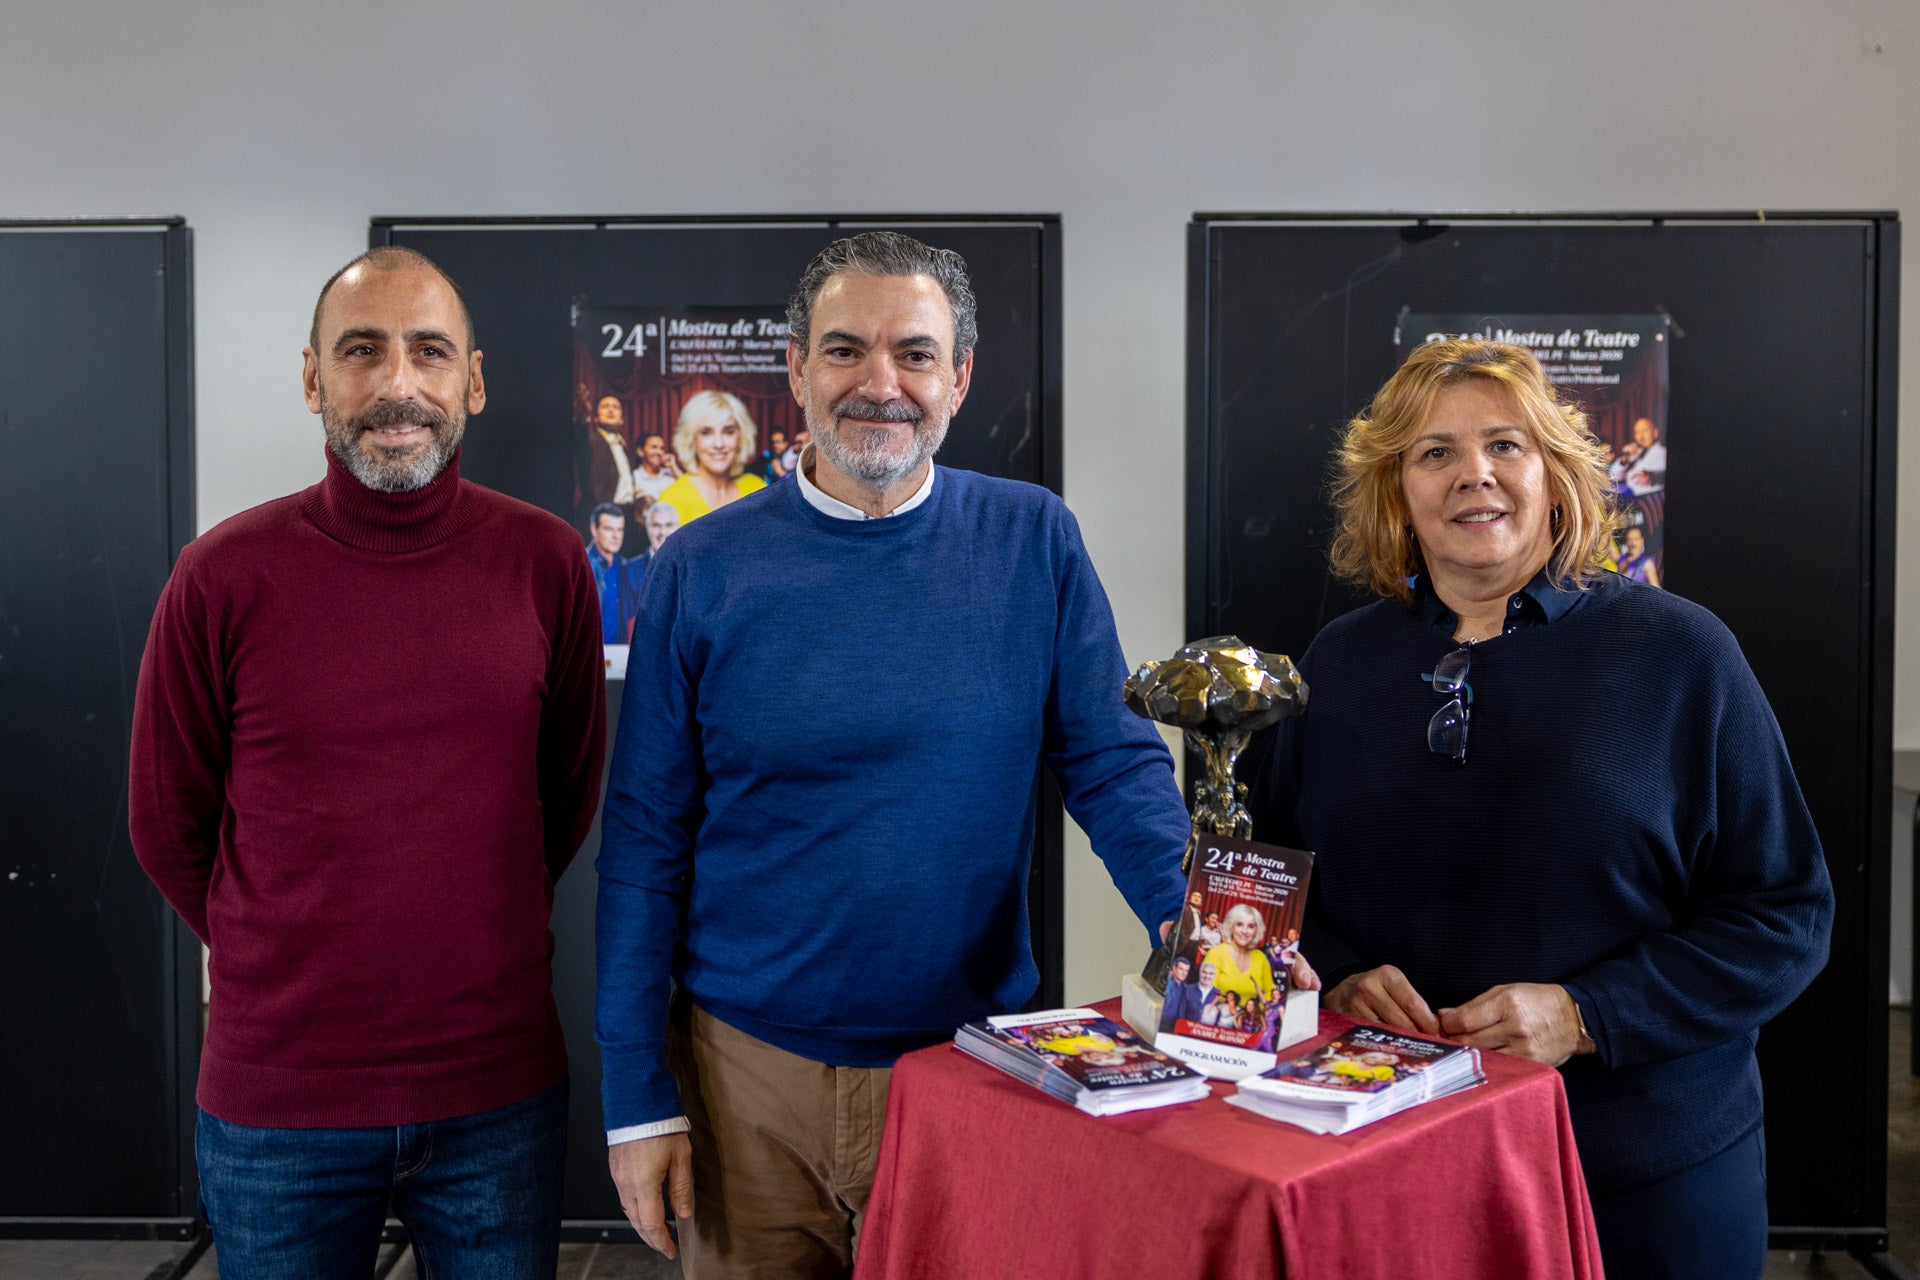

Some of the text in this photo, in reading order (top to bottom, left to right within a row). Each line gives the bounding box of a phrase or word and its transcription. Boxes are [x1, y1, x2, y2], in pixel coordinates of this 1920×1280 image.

[667, 319, 729, 336] Mostra
[730, 318, 754, 336] de
[601, 323, 658, 357] 24ª
[1495, 329, 1554, 347] Mostra
[1556, 329, 1580, 347] de
[1584, 329, 1641, 347] Teatre
[1570, 350, 1598, 360] Marzo
[1204, 848, 1286, 871] 24ª Mostra
[1242, 864, 1297, 884] de Teatre
[1180, 1048, 1248, 1067] PROGRAMACIÓN
